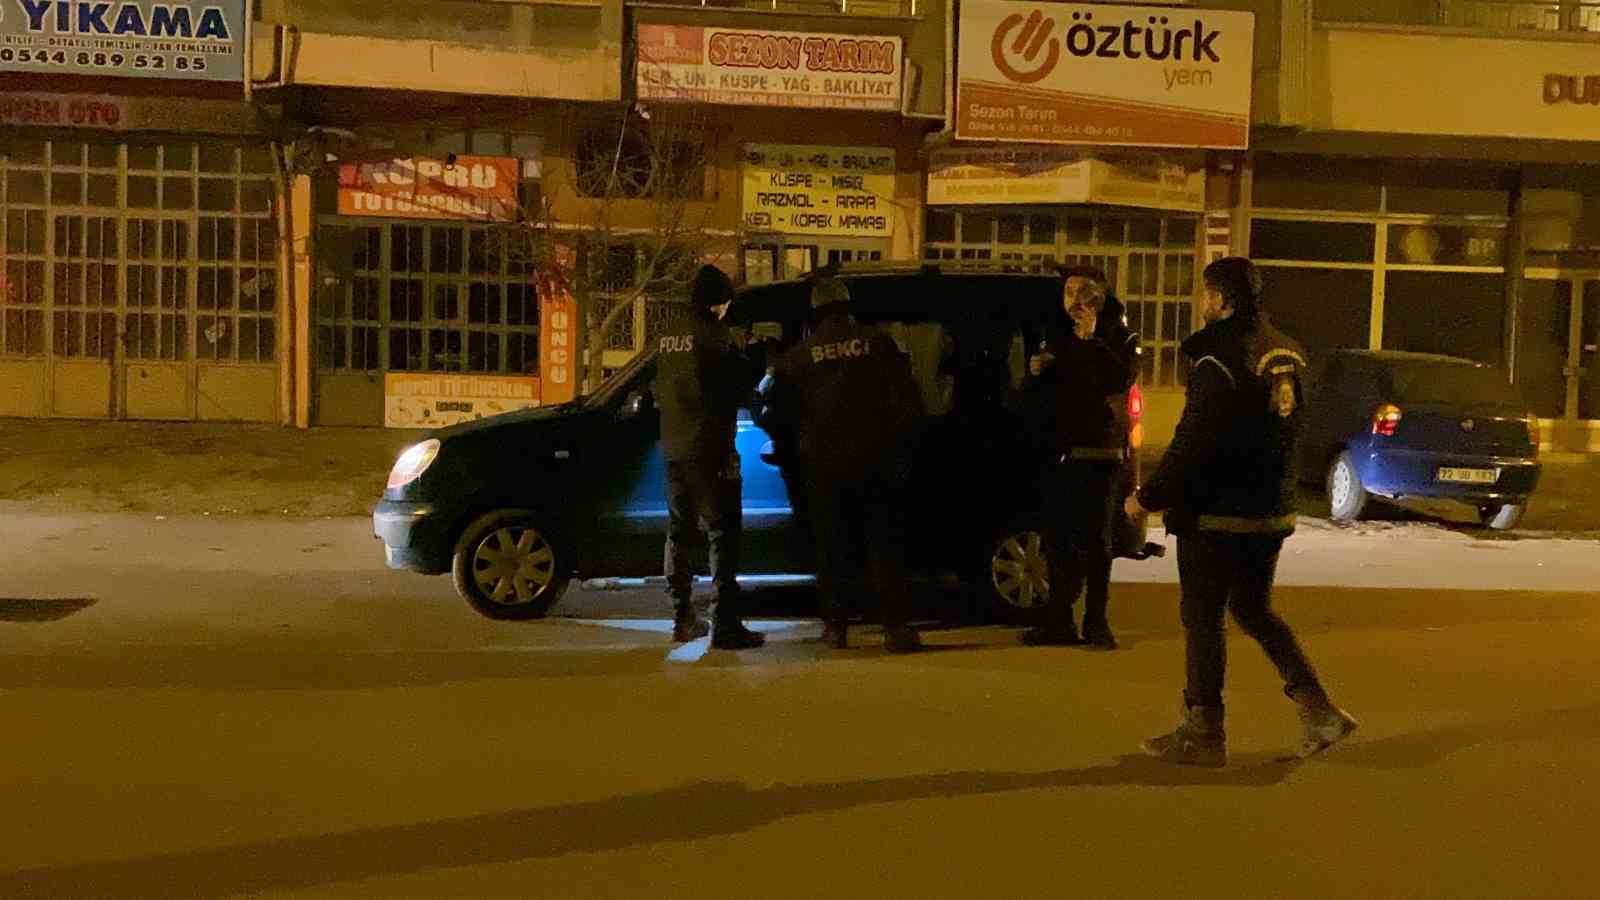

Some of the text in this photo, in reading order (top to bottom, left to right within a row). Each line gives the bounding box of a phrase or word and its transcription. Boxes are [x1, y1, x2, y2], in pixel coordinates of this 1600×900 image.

[19, 0, 230, 39] YIKAMA
[1066, 12, 1221, 63] öztürk
[0, 48, 206, 70] 0544 889 52 85
[709, 31, 895, 75] SEZON TARIM
[1163, 67, 1213, 90] yem
